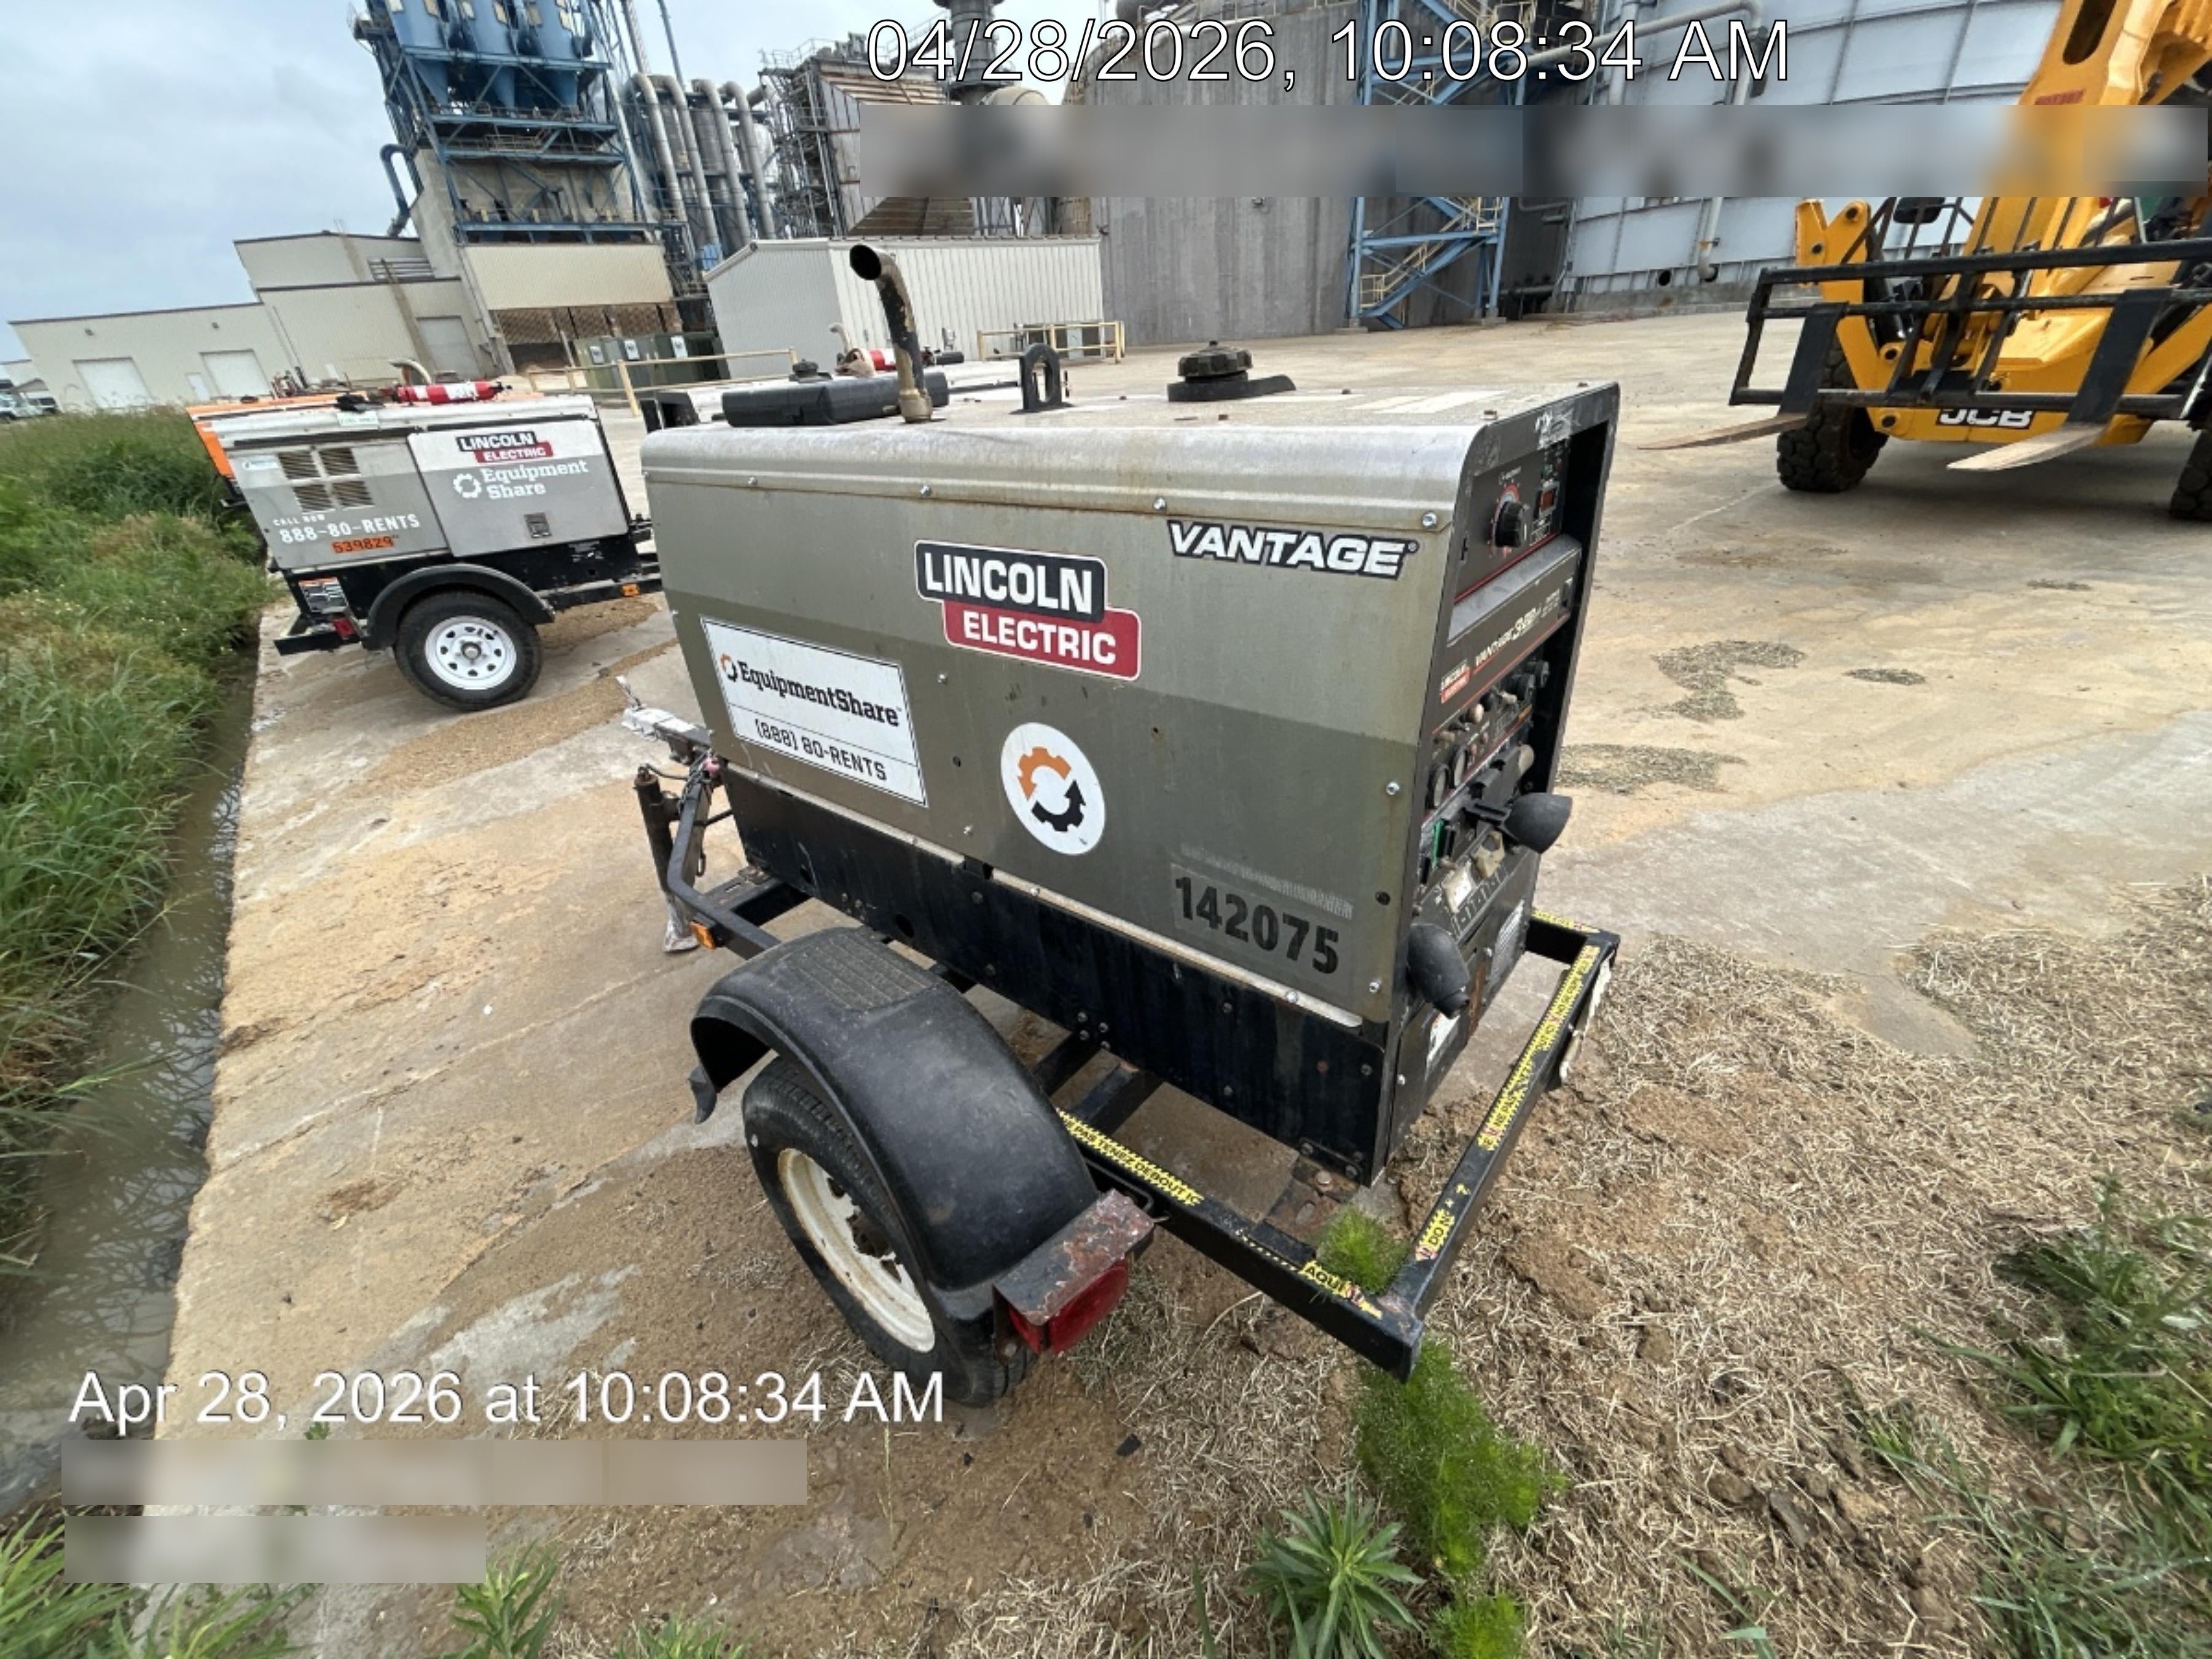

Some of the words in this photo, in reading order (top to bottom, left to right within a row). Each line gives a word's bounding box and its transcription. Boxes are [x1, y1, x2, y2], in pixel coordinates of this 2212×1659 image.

[1940, 408, 2033, 428] JCB
[460, 432, 535, 450] LINCOLN
[482, 447, 546, 461] ELECTRIC
[480, 460, 589, 484] Equipment
[486, 482, 546, 499] Share
[279, 514, 421, 544] 888-80-RENTS
[1168, 521, 1408, 579] VANTAGE
[924, 552, 1092, 615] LINCOLN
[963, 610, 1117, 665] ELECTRIC
[737, 661, 900, 727] EquipmentShare
[755, 718, 799, 751] (888)
[801, 736, 887, 781] 80-RENTS
[1175, 876, 1339, 974] 142075
